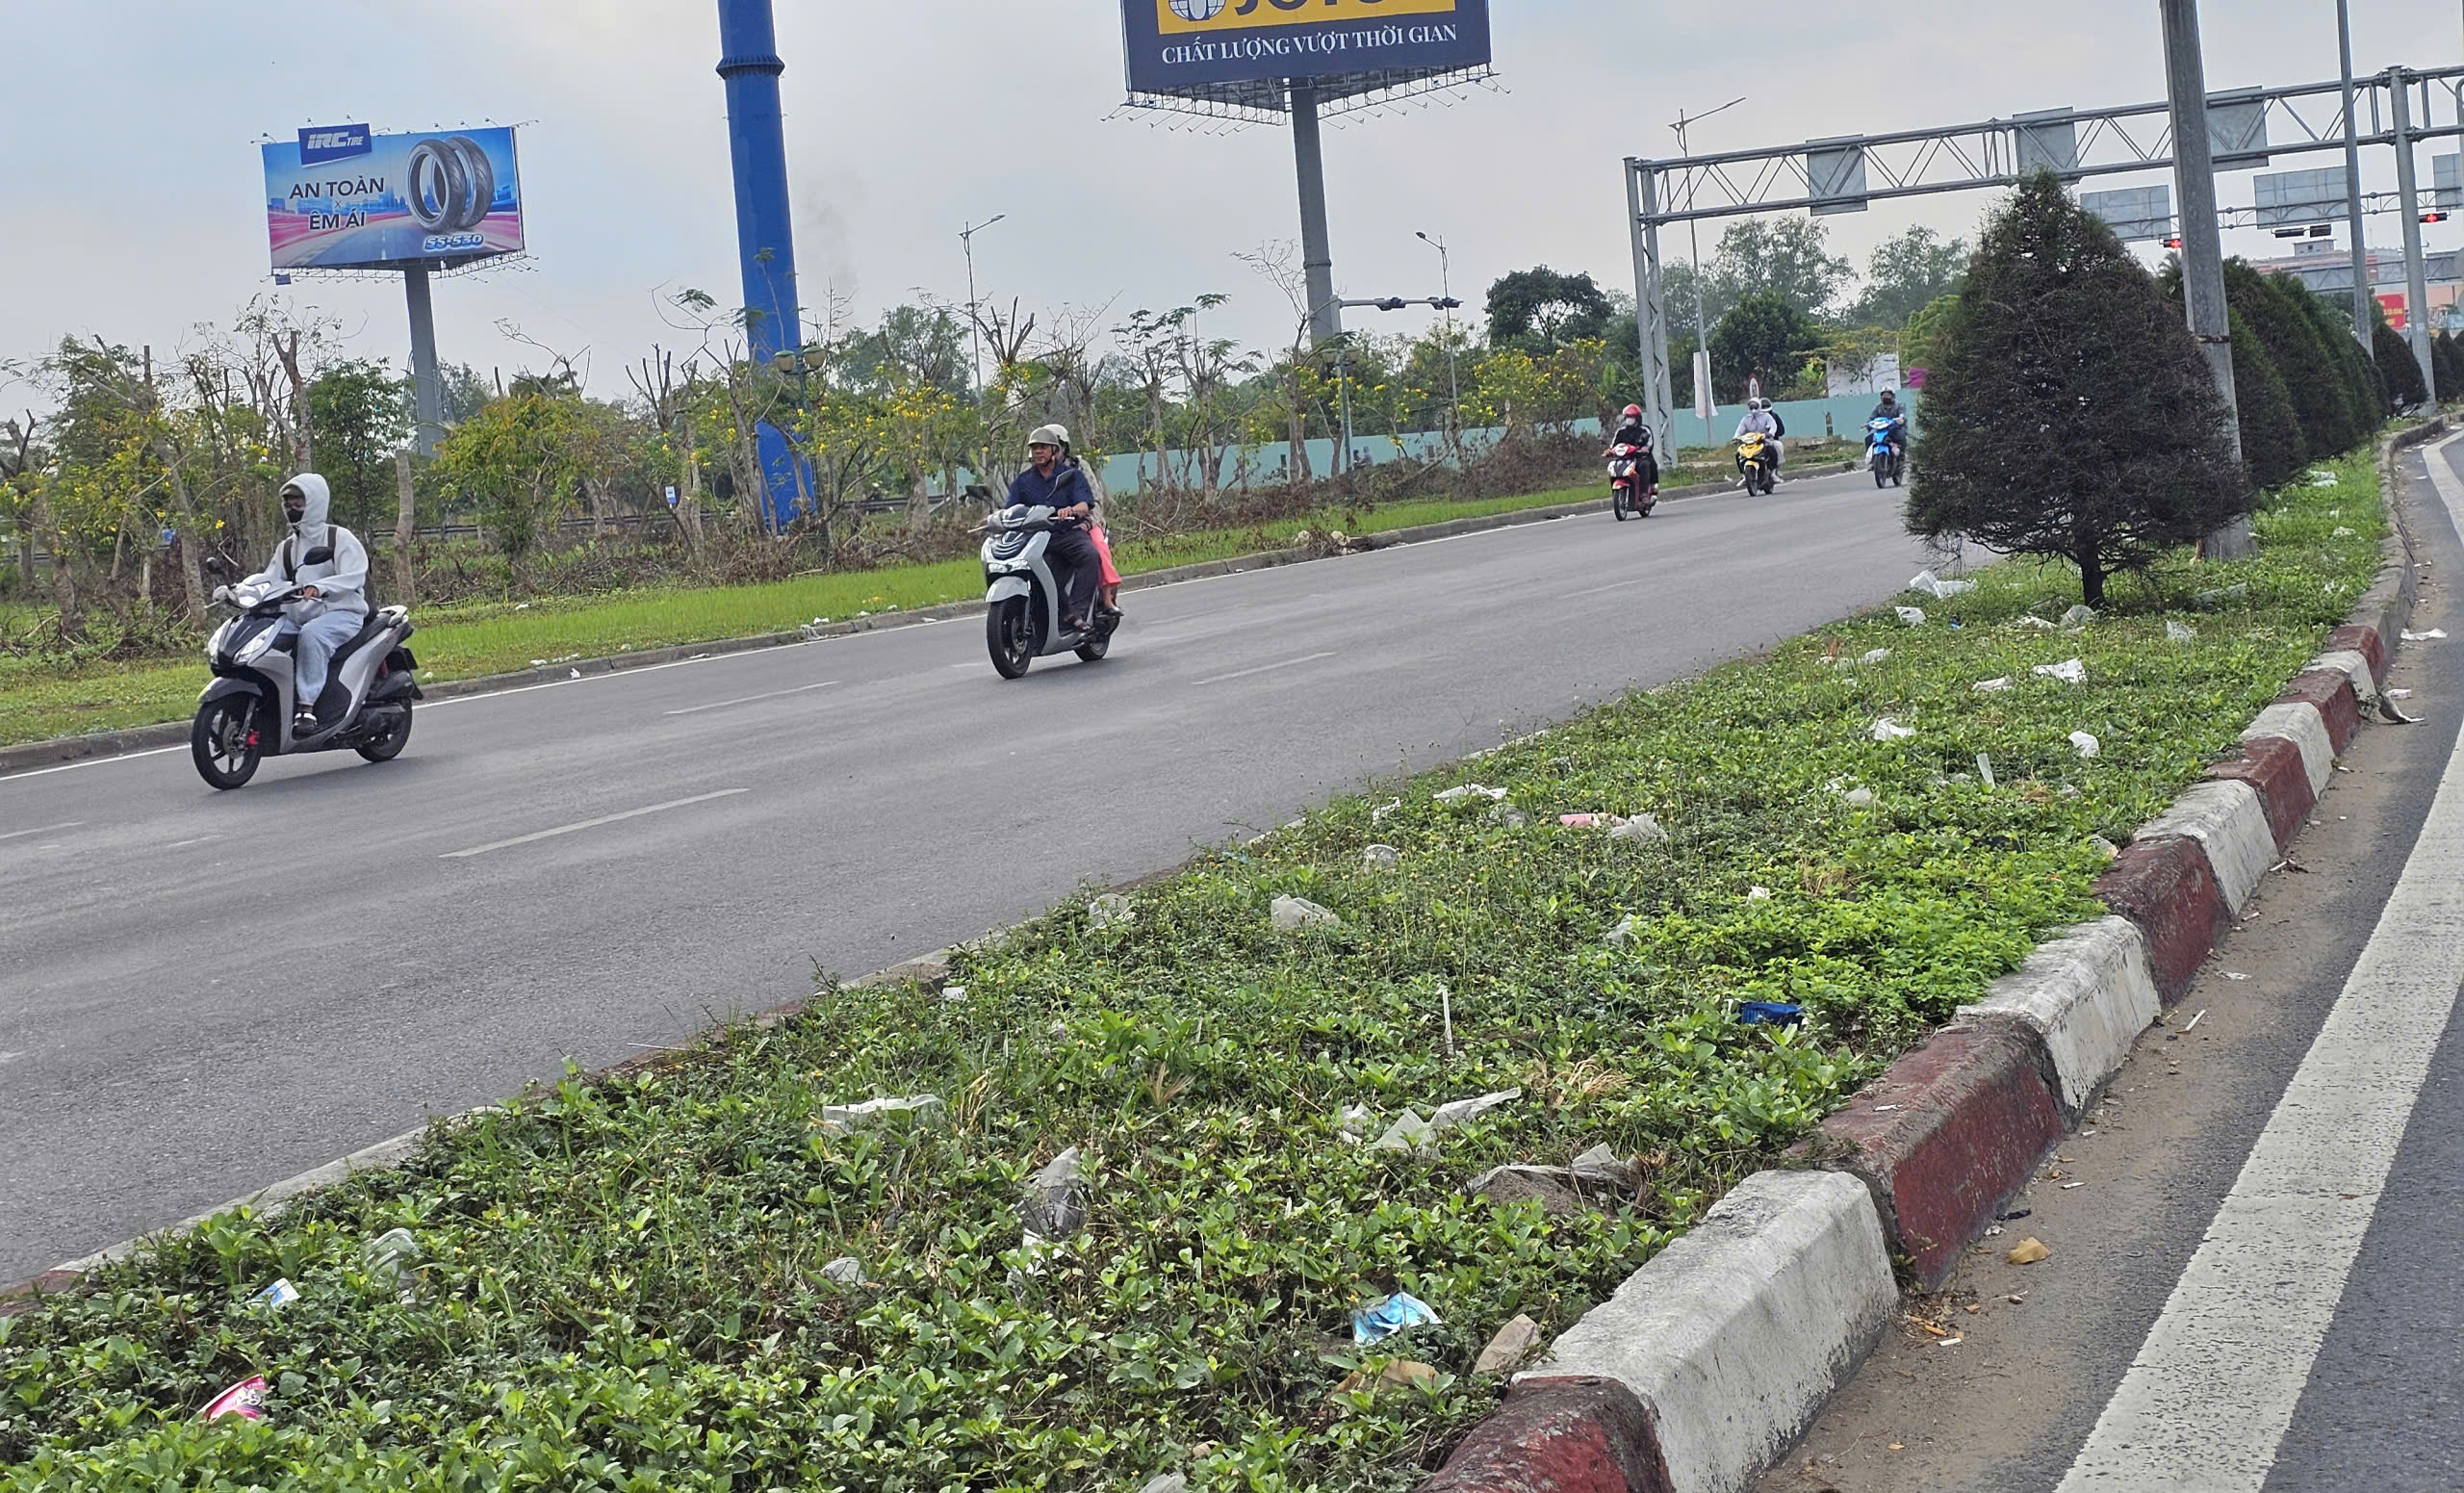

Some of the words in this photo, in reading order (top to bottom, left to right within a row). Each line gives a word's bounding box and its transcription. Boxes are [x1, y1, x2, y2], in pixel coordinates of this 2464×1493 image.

[1162, 36, 1216, 64] CHẤT
[1220, 38, 1290, 61] LƯỢNG
[1293, 31, 1348, 54] VƯỢT
[1352, 24, 1403, 48] THỜI
[1408, 23, 1457, 43] GIAN
[346, 136, 364, 146] TIRE
[289, 182, 321, 199] AN
[326, 175, 384, 196] TOÀN
[309, 211, 340, 230] ÊM
[346, 208, 365, 228] ÁI
[424, 234, 484, 249] SS-530
